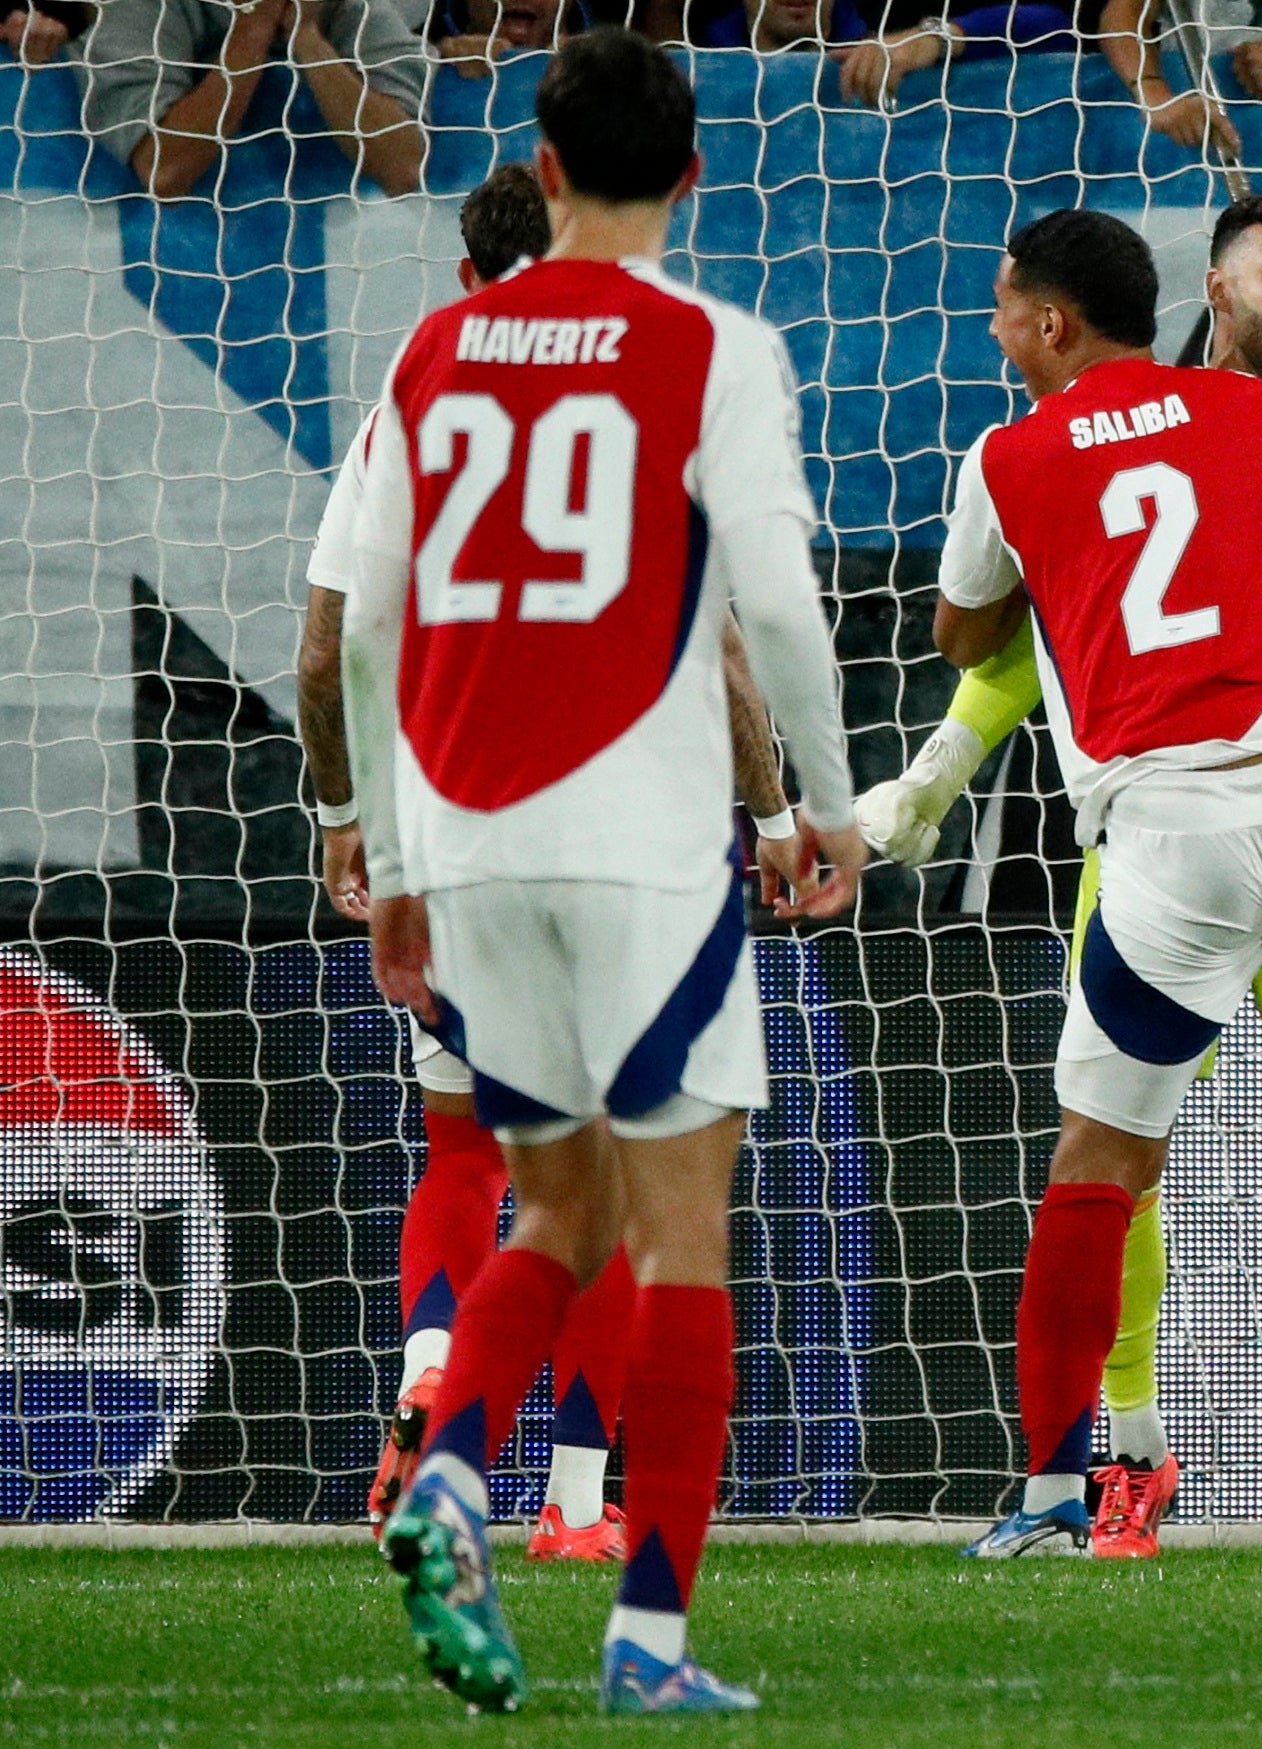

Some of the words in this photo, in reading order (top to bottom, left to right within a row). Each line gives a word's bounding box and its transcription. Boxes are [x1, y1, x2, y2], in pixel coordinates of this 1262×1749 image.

[456, 315, 630, 365] HAVERTZ
[1068, 393, 1191, 450] SALIBA
[414, 391, 640, 627] 29
[1098, 460, 1221, 656] 2
